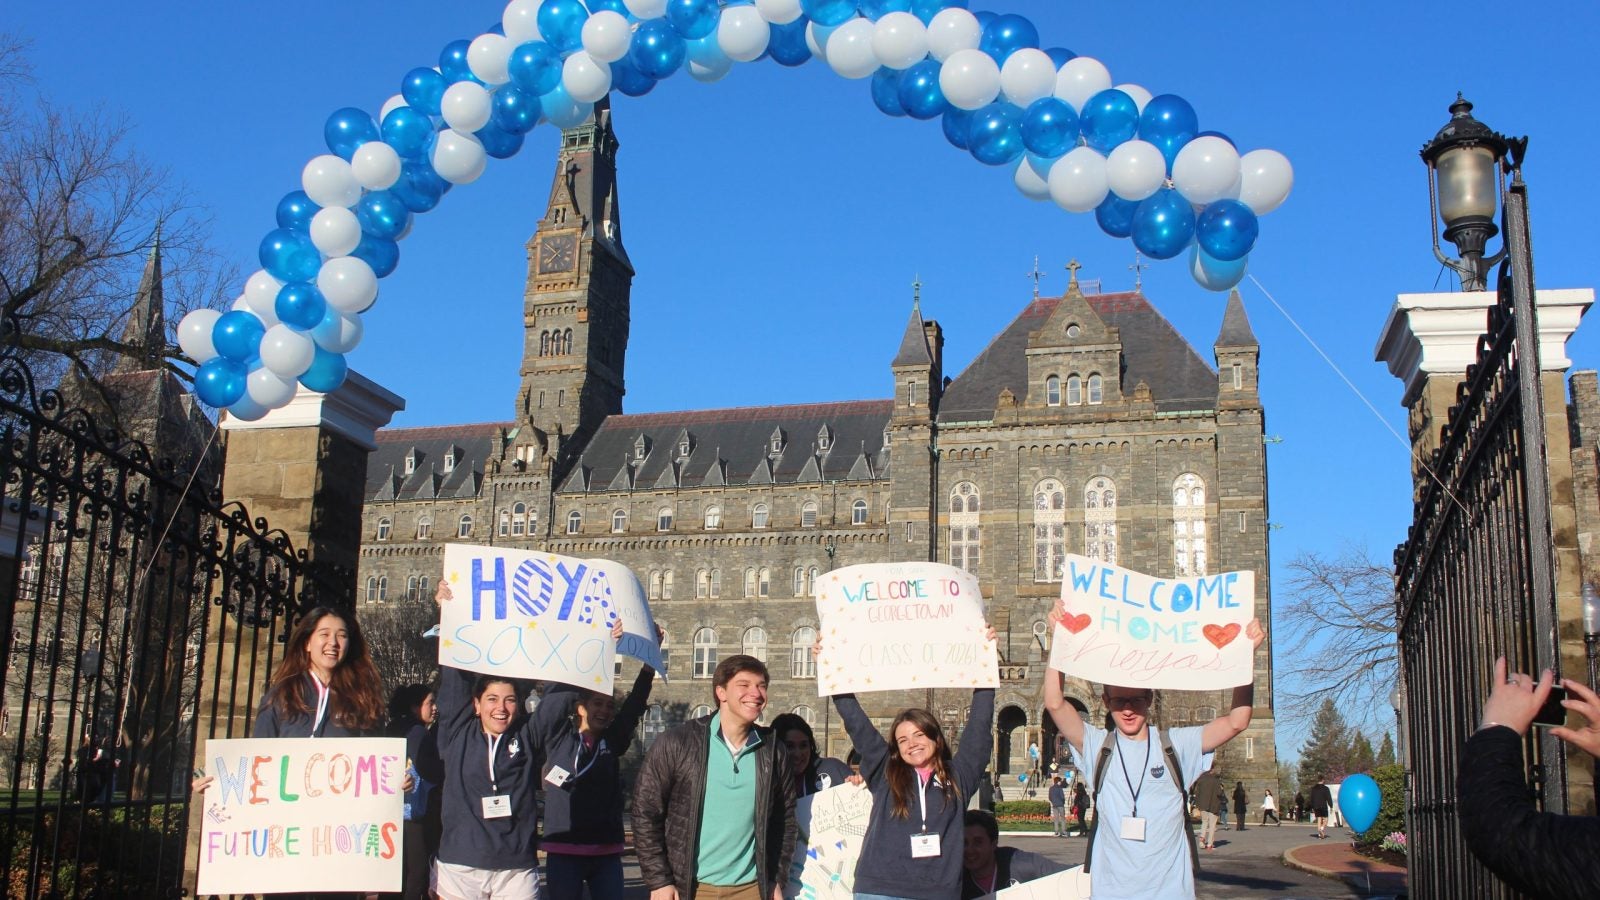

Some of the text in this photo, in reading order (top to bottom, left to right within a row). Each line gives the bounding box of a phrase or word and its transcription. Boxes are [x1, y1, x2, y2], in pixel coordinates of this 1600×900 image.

[471, 557, 616, 628] HOYA
[842, 579, 960, 603] WELCOME TO
[1070, 561, 1240, 613] WELCOME
[868, 603, 954, 623] GEORGETOWN!
[1100, 606, 1199, 644] HOME
[858, 643, 913, 667] CLASS
[922, 643, 937, 665] OF
[215, 752, 399, 806] WELCOME
[208, 822, 398, 863] FUTURE HOYAS
